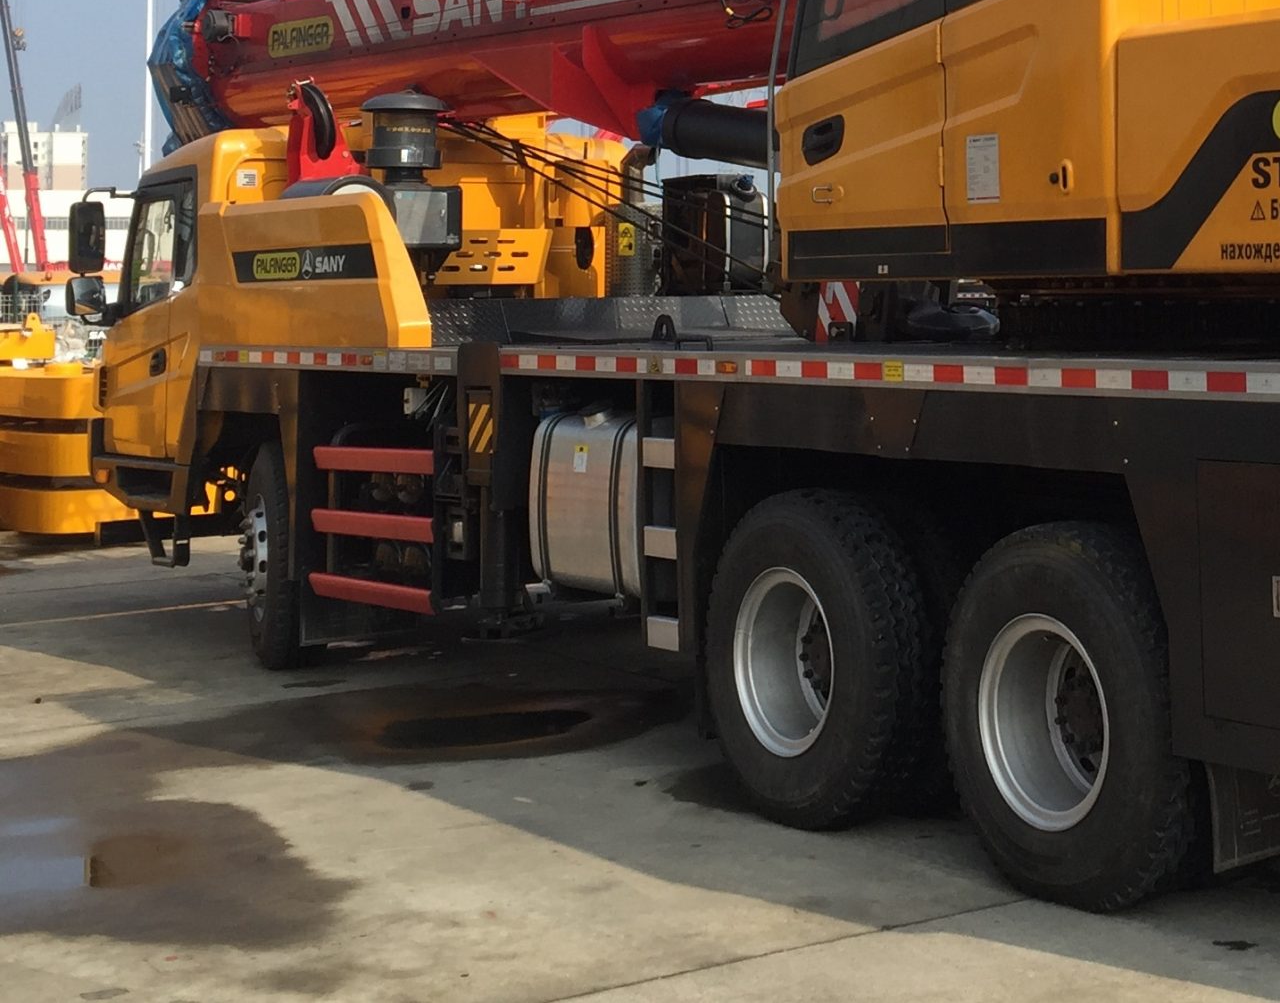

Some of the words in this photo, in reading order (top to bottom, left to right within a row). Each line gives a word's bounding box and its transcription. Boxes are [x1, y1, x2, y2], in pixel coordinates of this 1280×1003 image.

[271, 22, 331, 51] PALFINGER
[256, 256, 297, 274] PALFINGER
[315, 254, 346, 274] SANY
